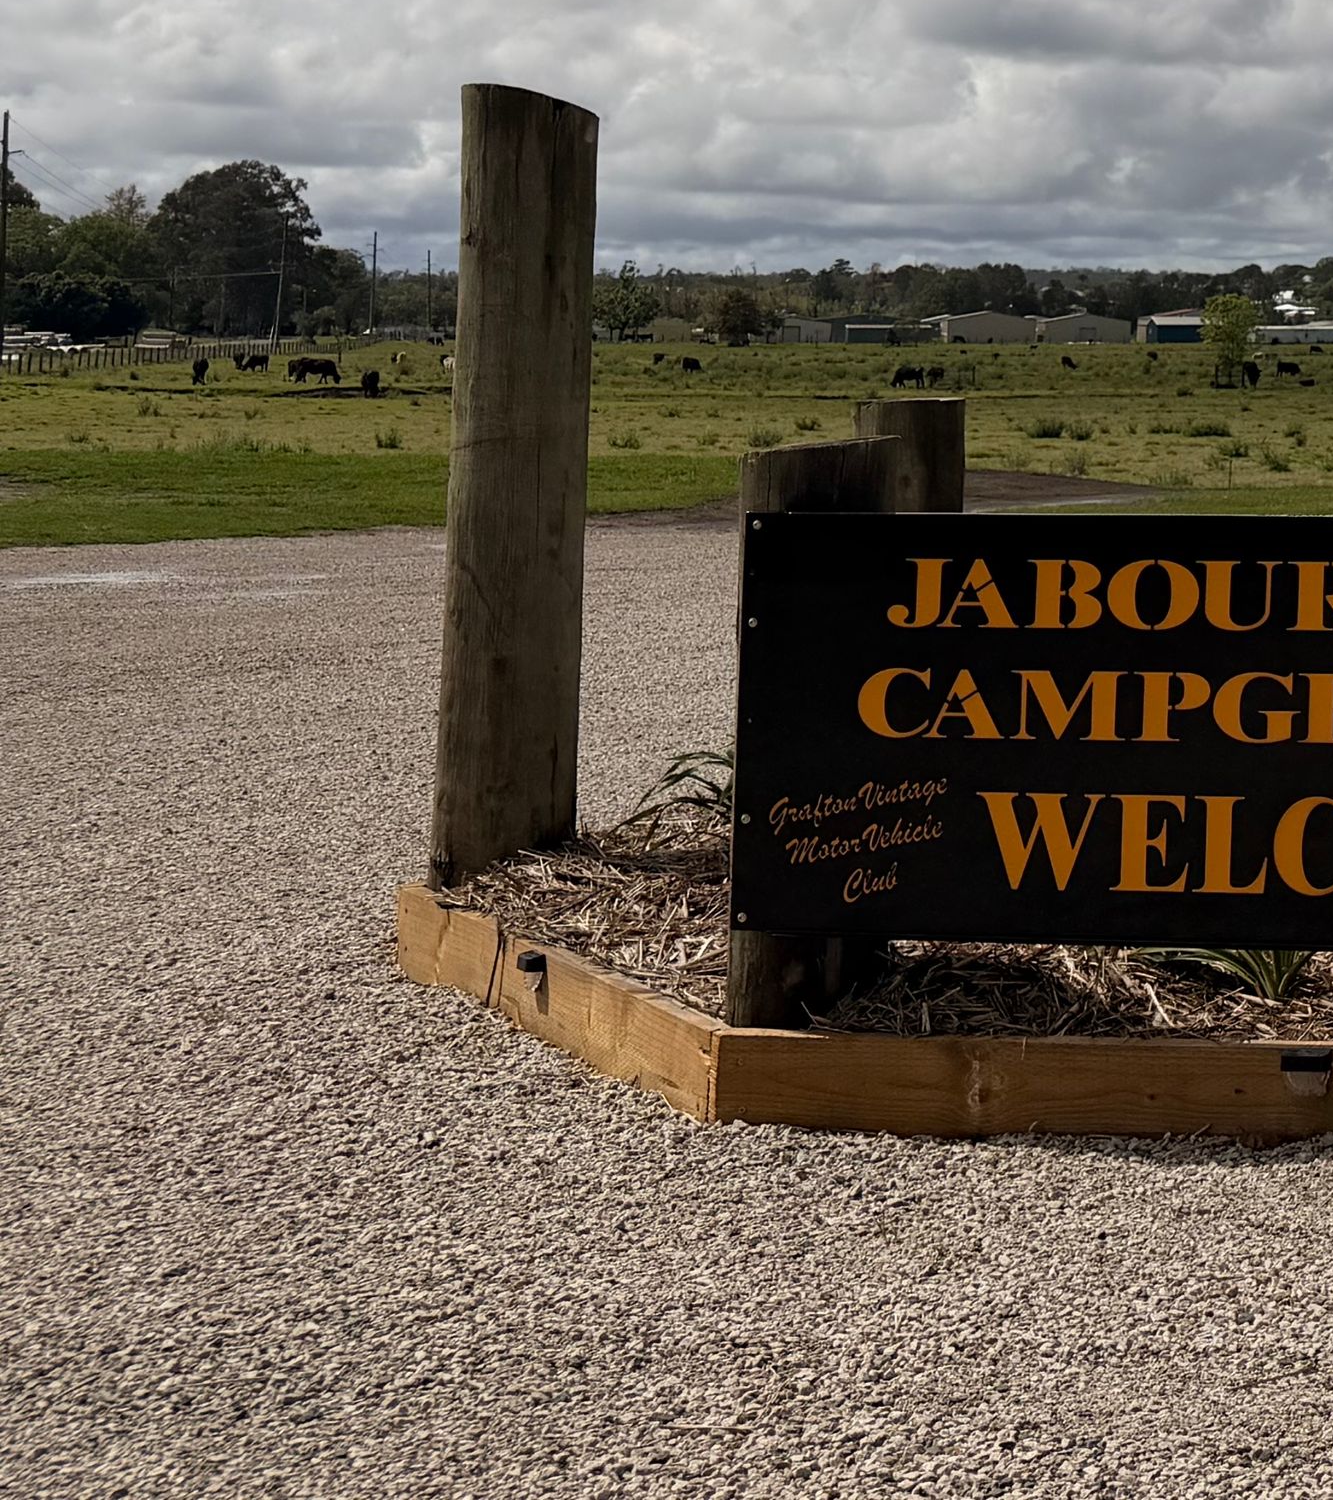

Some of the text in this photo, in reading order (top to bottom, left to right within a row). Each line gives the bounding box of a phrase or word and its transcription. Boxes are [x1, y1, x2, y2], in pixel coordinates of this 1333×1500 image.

[768, 778, 947, 835] Grafton Vintage
[785, 814, 944, 865] Motor Vehicle
[843, 861, 898, 903] Club
